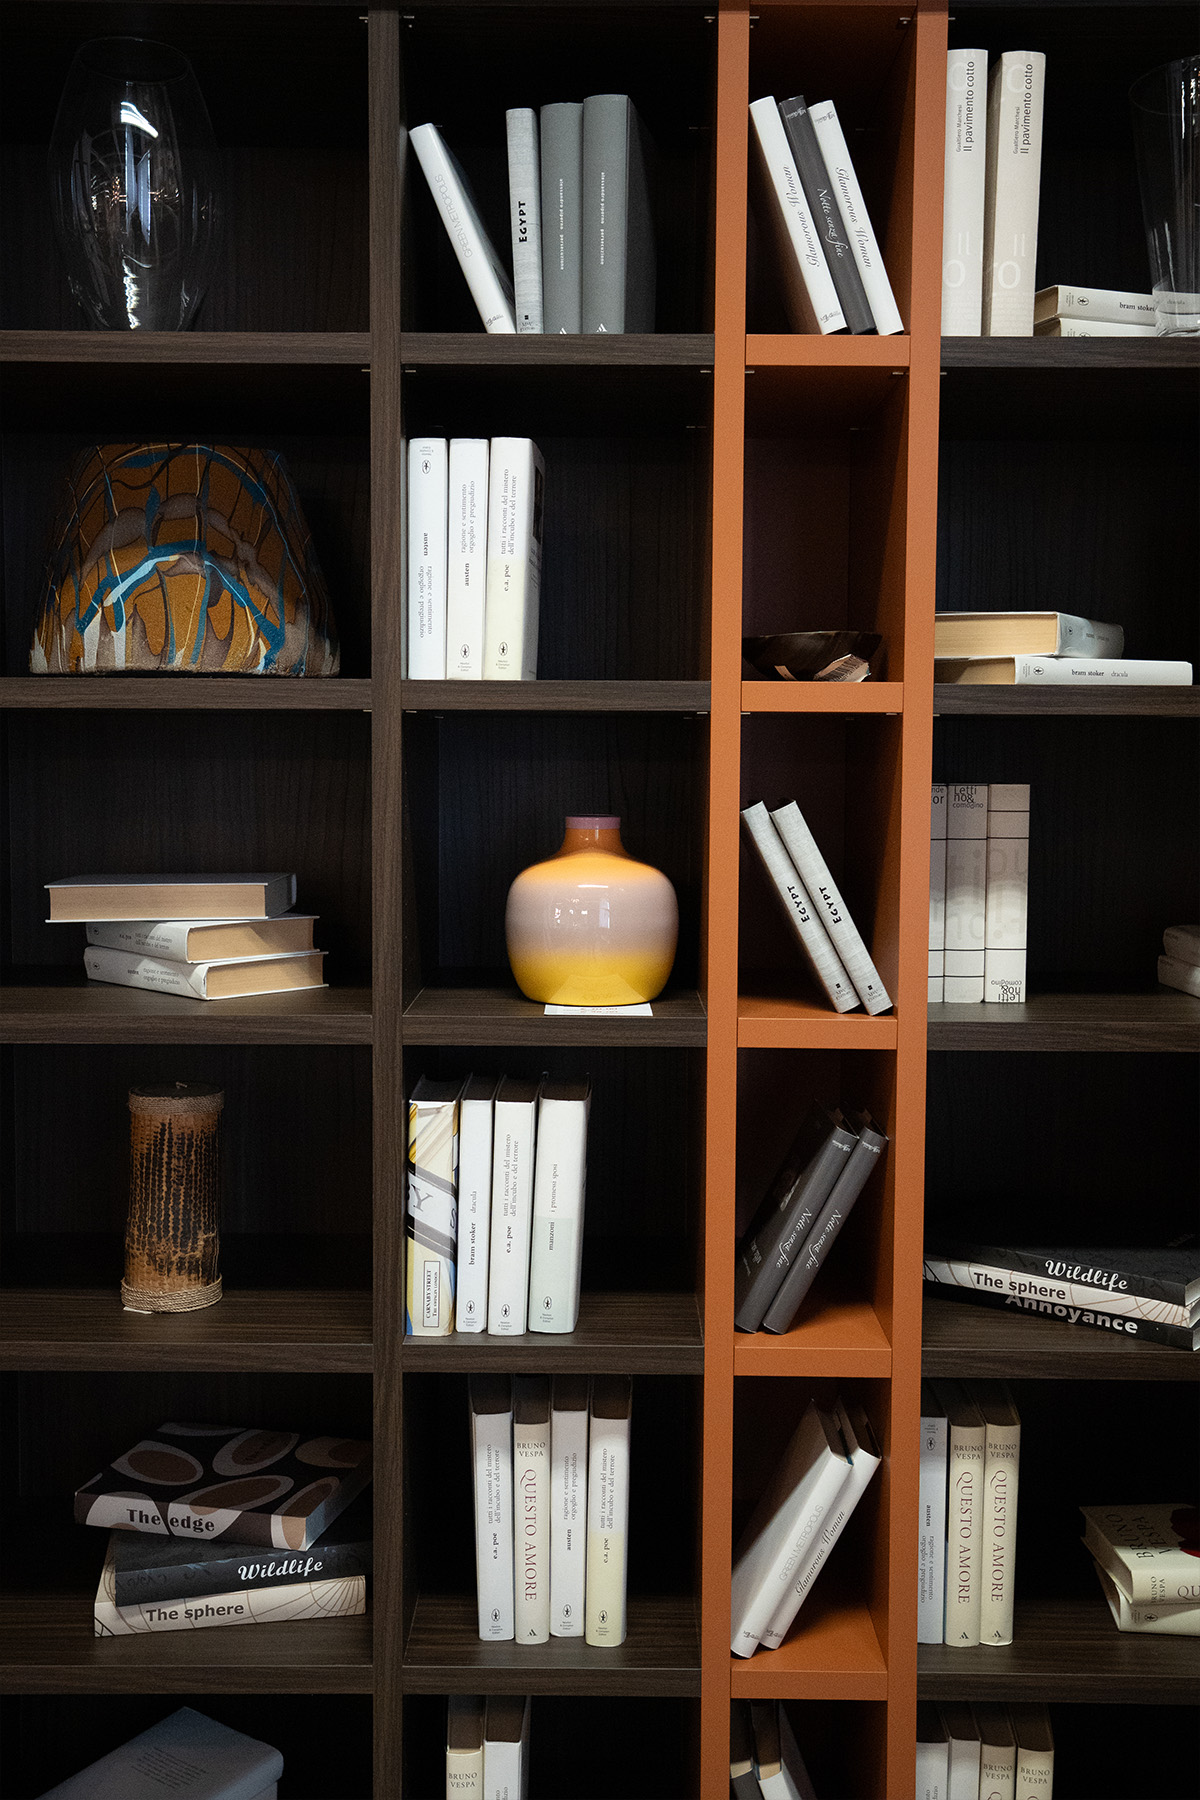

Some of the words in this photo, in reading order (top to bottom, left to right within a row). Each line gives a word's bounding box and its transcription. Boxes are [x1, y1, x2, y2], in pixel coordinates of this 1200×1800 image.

[966, 60, 975, 87] cotto
[1024, 63, 1032, 90] cotto
[964, 89, 975, 144] pavimento
[1020, 92, 1032, 145] pavimento
[963, 144, 972, 152] Il
[783, 166, 800, 207] Woman
[816, 188, 831, 214] Notte
[518, 200, 527, 242] EGYPT
[825, 213, 838, 241] senza
[835, 166, 857, 222] Glamorous
[854, 226, 871, 267] Woman
[797, 211, 820, 268] Glamorous
[828, 236, 848, 258] fine
[1118, 301, 1135, 309] bram
[461, 483, 469, 520] sentimento
[460, 528, 469, 553] ragione
[786, 885, 810, 922] EGYPT
[818, 886, 842, 924] EGYPT
[973, 1272, 1004, 1289] The
[1008, 1278, 1066, 1300] sphere
[1045, 1260, 1128, 1291] Wildlife
[1004, 1294, 1138, 1334] Annoyance
[516, 1441, 546, 1449] BRUNO
[519, 1450, 544, 1458] VESPA
[953, 1444, 983, 1452] BRUNO
[955, 1452, 981, 1460] VESPA
[988, 1442, 1017, 1451] BRUNO
[990, 1451, 1015, 1459] VESPA
[519, 1468, 536, 1536] QUESTO
[955, 1471, 973, 1538] QUESTO
[990, 1469, 1007, 1537] QUESTO
[126, 1508, 161, 1526] The
[169, 1516, 215, 1533] edge
[795, 1549, 825, 1597] Glamorous
[821, 1510, 846, 1545] Woman
[237, 1557, 324, 1581] Wildlife
[524, 1541, 536, 1600] AMORE
[957, 1544, 970, 1603] AMORE
[990, 1542, 1004, 1601] AMORE
[146, 1609, 179, 1622] The
[184, 1603, 245, 1620] sphere
[448, 1772, 478, 1780] BRUNO
[983, 1764, 1013, 1772] BRUNO
[985, 1772, 1010, 1780] VESPA
[1020, 1767, 1050, 1776] BRUNO
[1022, 1776, 1048, 1784] VESPA
